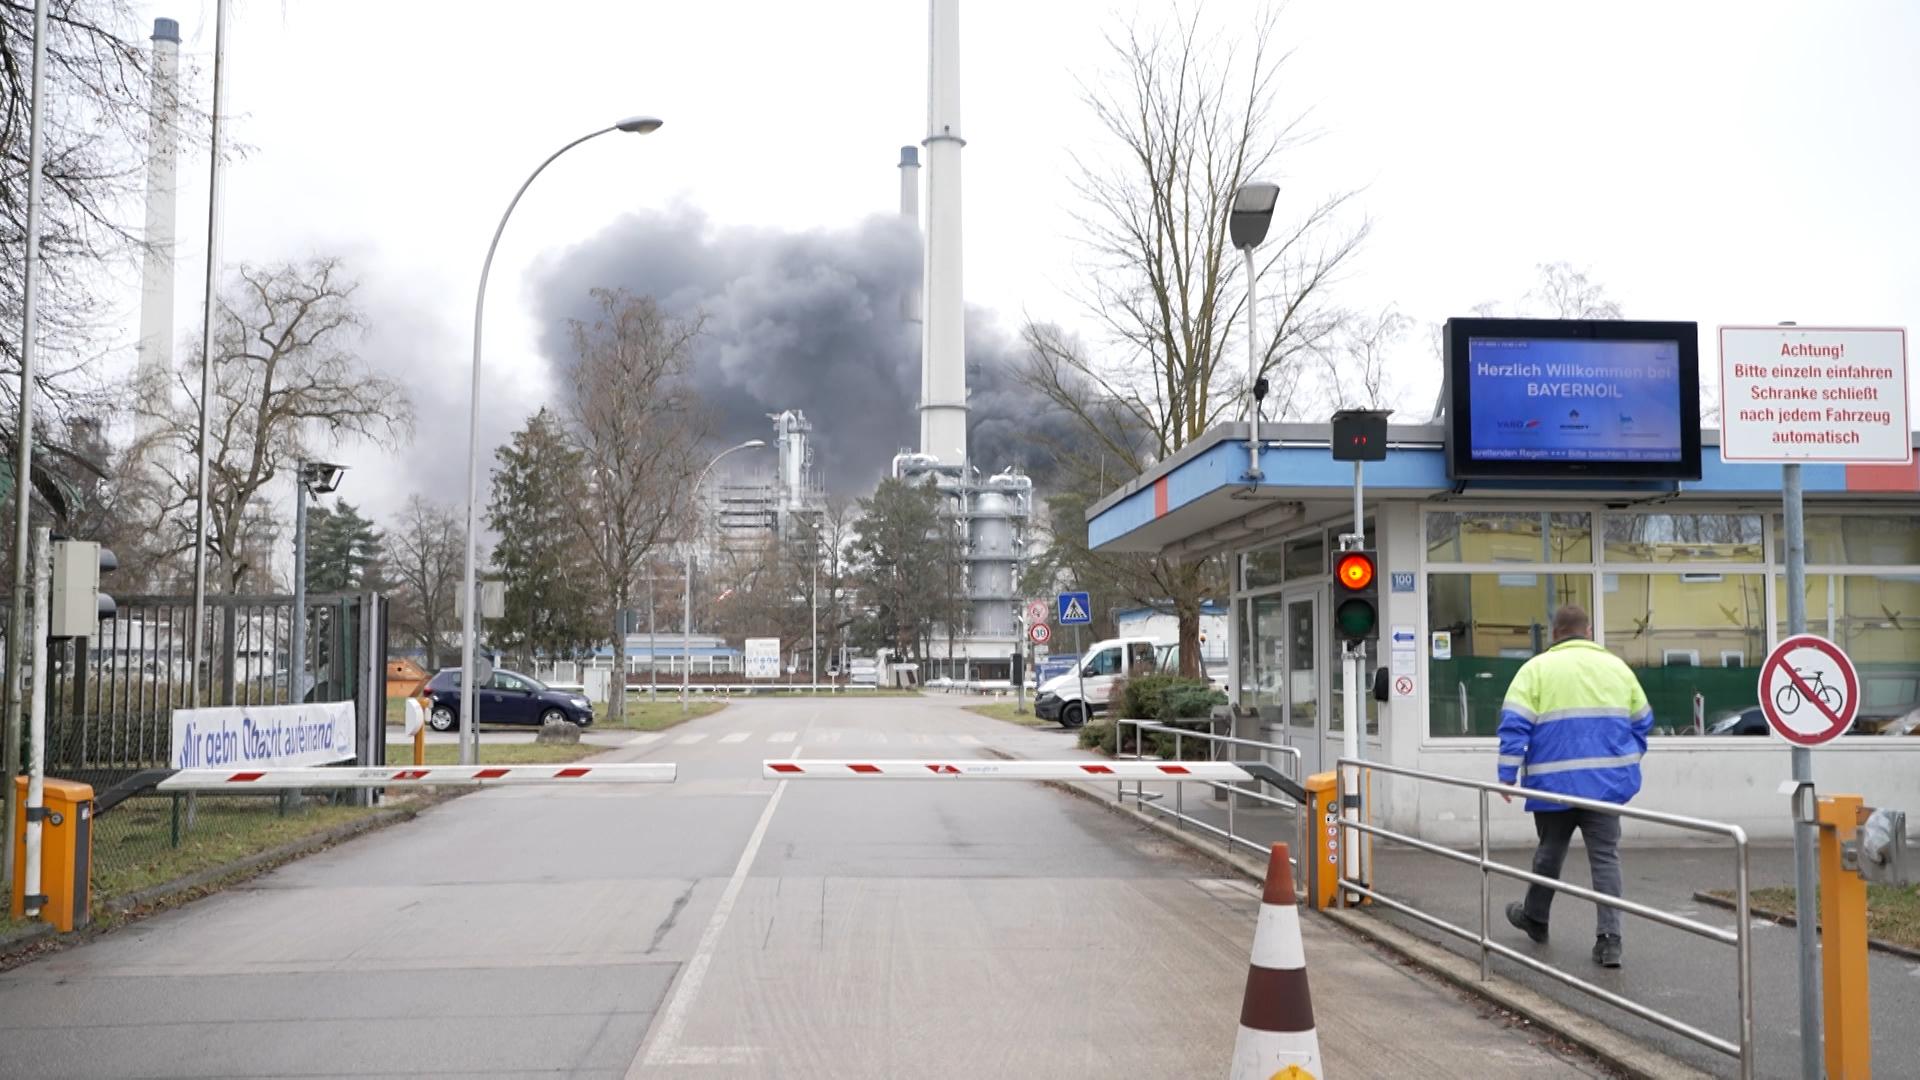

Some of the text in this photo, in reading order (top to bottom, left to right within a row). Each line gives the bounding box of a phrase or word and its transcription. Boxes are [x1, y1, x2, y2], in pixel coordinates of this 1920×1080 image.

[1781, 343, 1844, 360] Achtung!
[1477, 362, 1671, 379] Herzlich Willkommen bei
[1735, 363, 1893, 379] Bitte einzeln einfahren
[1527, 383, 1623, 398] BAYERNOIL
[1751, 385, 1878, 400] Schranke schließt
[1740, 407, 1890, 425] nach jedem Fahrzeug
[1772, 430, 1860, 444] automatisch
[1395, 575, 1412, 585] 100
[205, 719, 237, 768] gebn
